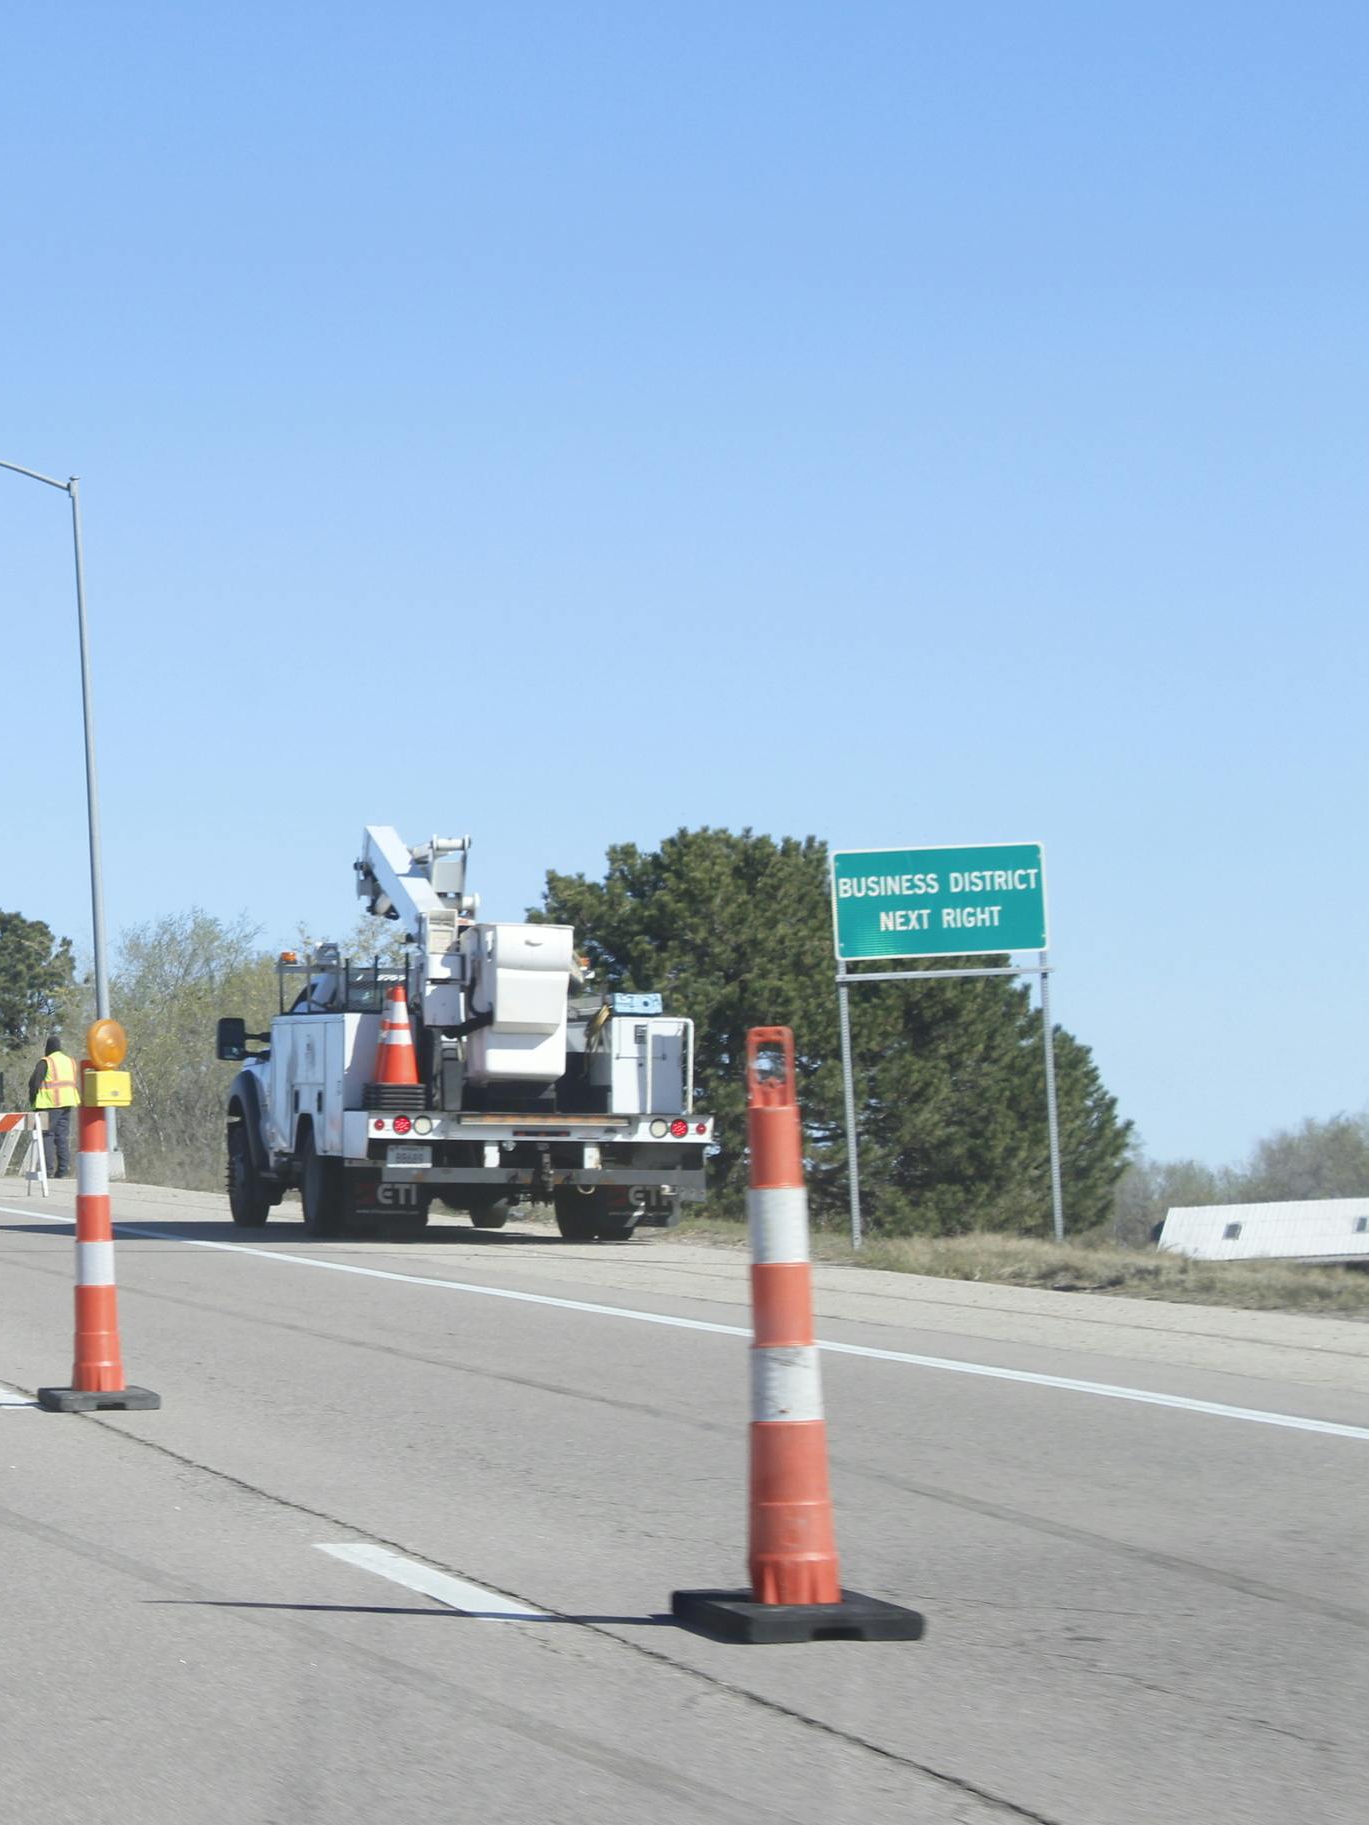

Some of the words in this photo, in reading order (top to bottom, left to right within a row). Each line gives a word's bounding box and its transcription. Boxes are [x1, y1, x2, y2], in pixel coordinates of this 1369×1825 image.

[838, 873, 939, 898] BUSINESS
[949, 869, 1038, 893] DISTRICT
[880, 909, 931, 931] NEXT
[941, 906, 1001, 928] RIGHT
[377, 1183, 417, 1205] ETI
